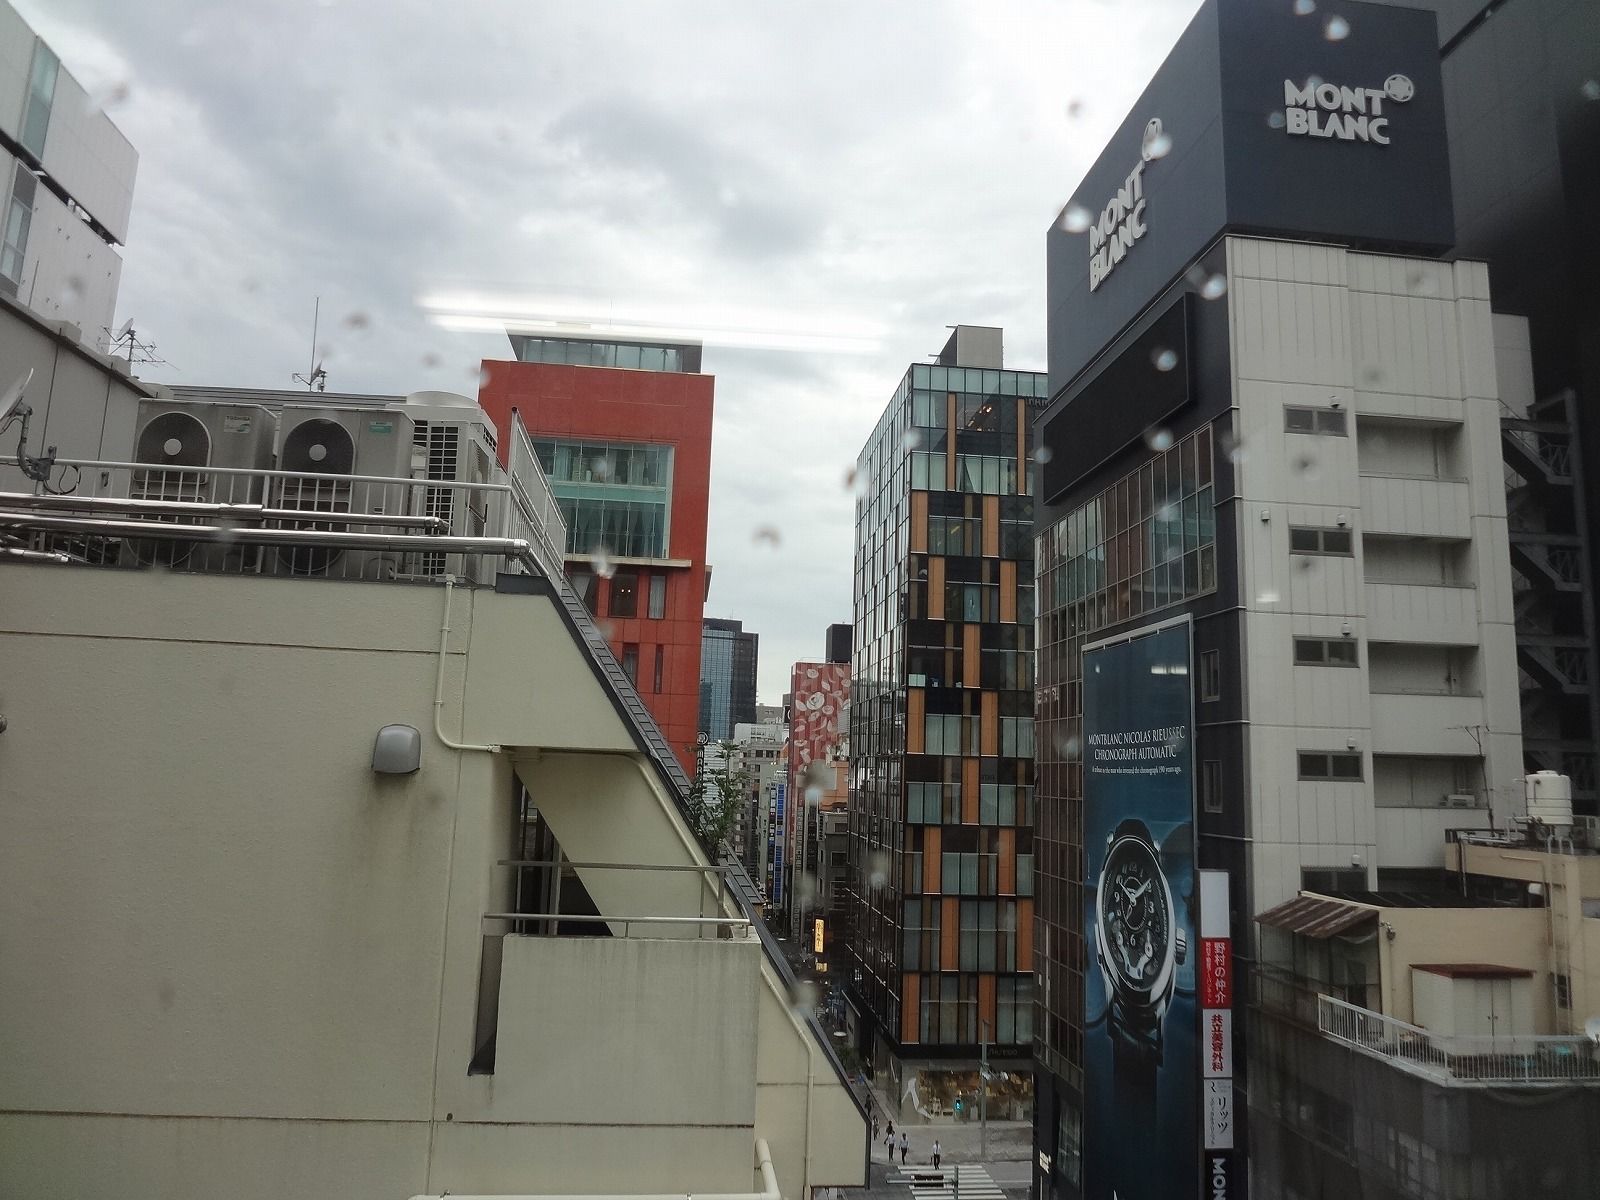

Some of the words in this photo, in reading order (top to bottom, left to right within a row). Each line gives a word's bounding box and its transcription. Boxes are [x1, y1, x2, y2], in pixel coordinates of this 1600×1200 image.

[1284, 79, 1386, 116] MONT
[1285, 107, 1390, 144] BLANC
[1090, 160, 1146, 256] MONT
[1090, 198, 1147, 292] BLANC
[1088, 732, 1123, 745] MONTBLANC
[1123, 729, 1151, 744] NICOLAS
[1152, 725, 1185, 742] RIEUSSEC
[1094, 748, 1138, 760] CHRONOGRAPH
[1139, 744, 1177, 760] AUTOMATIC
[1211, 1014, 1223, 1072] 共立美容外科
